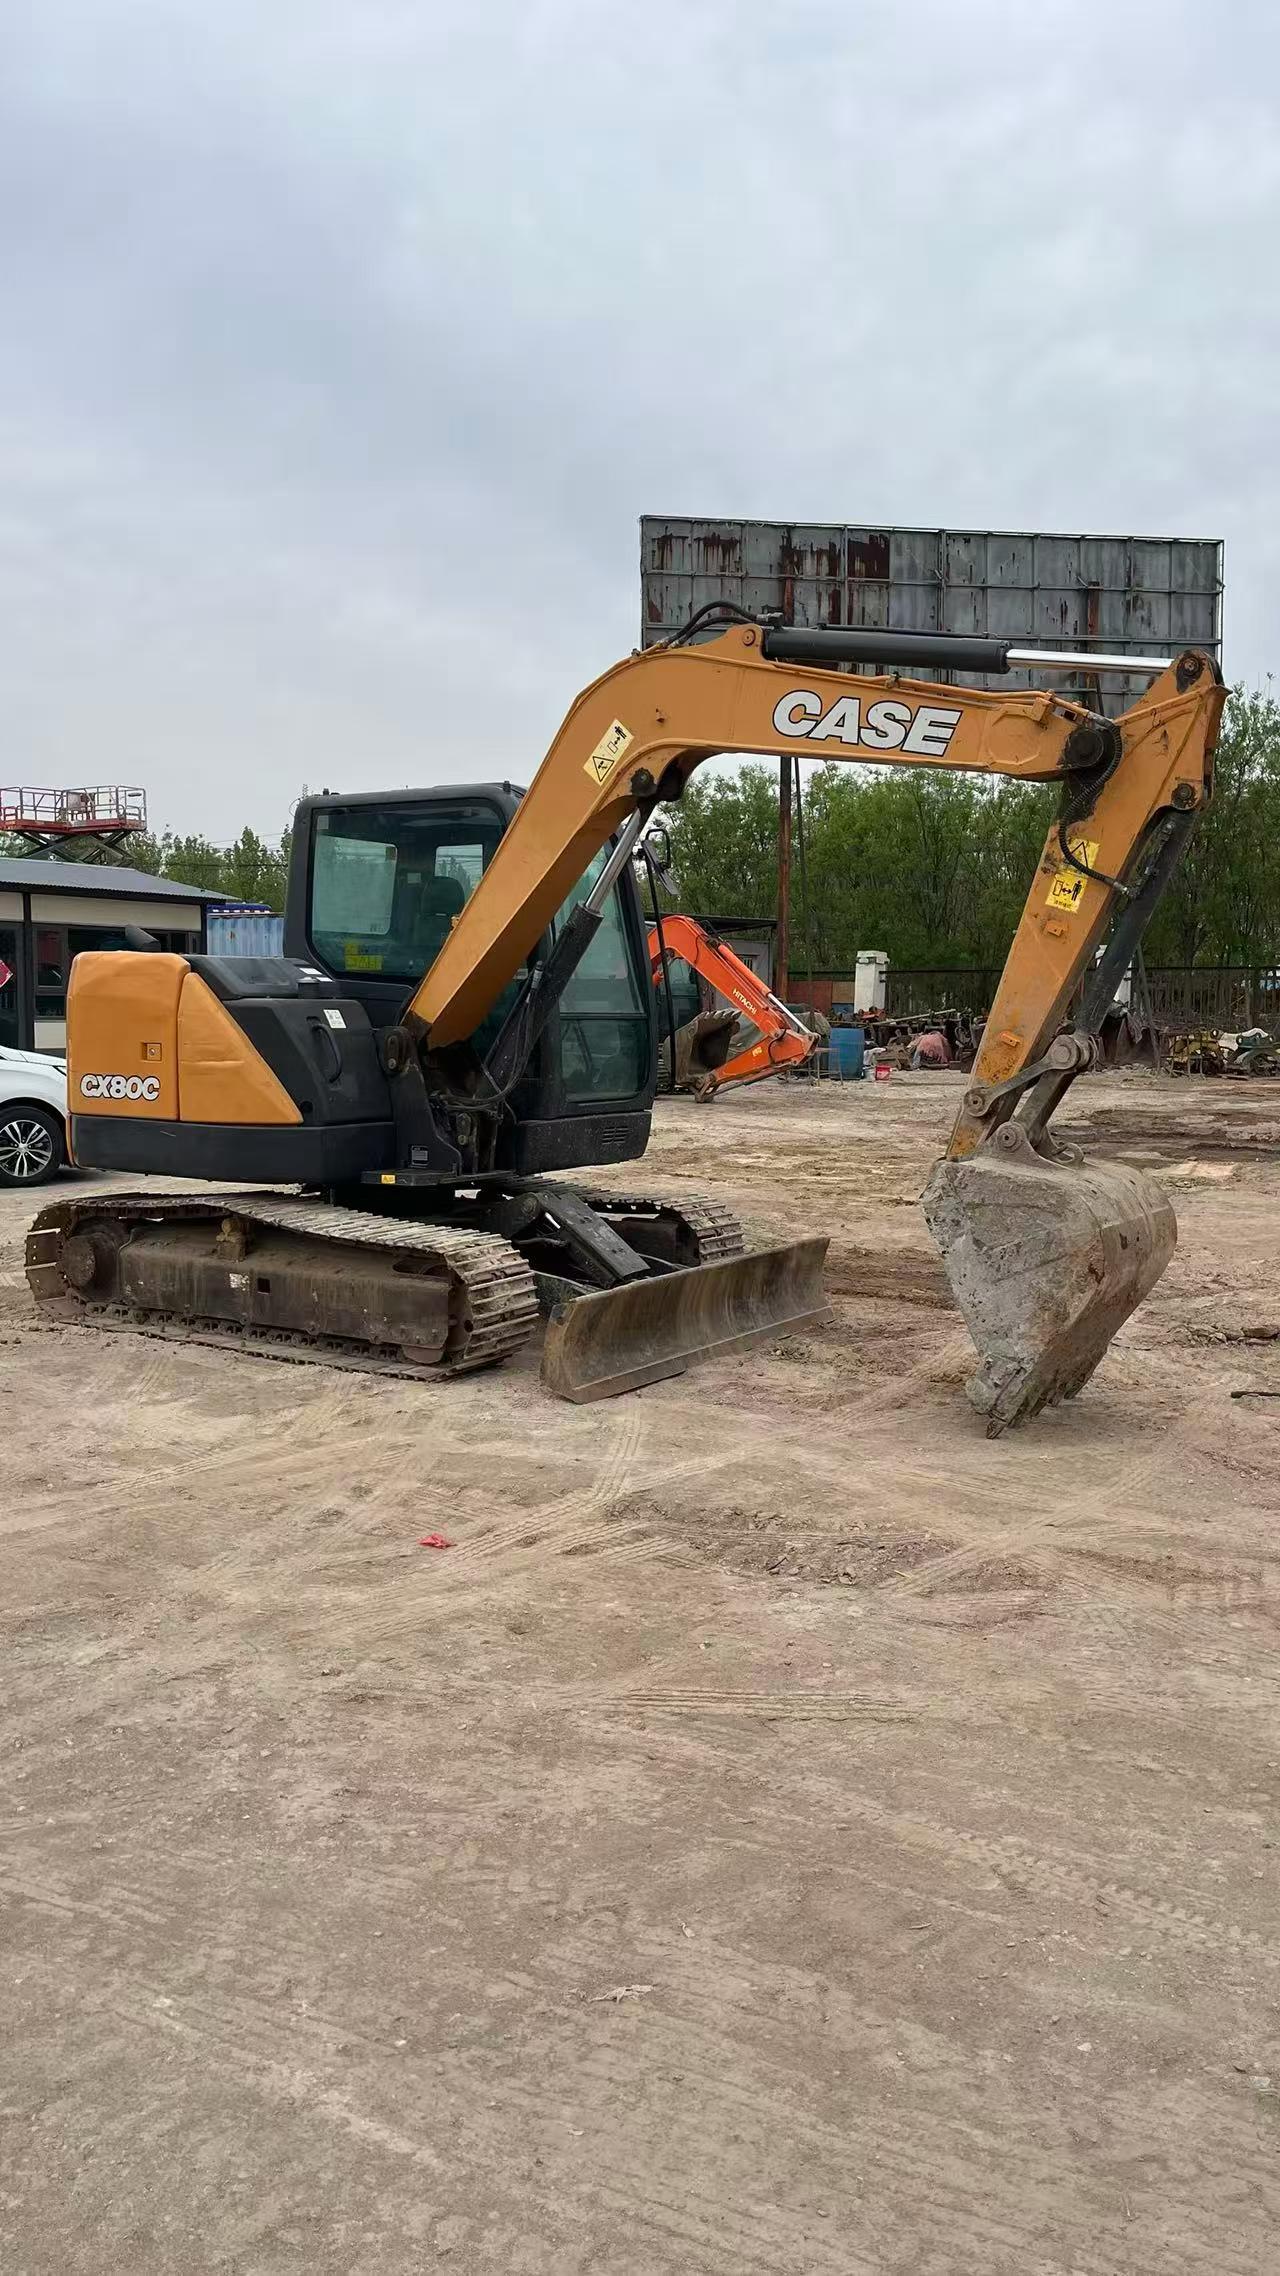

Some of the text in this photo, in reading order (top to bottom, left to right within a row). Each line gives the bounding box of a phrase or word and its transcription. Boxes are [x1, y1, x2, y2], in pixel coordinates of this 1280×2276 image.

[773, 690, 963, 757] CASE
[732, 988, 757, 1015] HITACHI
[80, 1073, 160, 1101] CX80C
